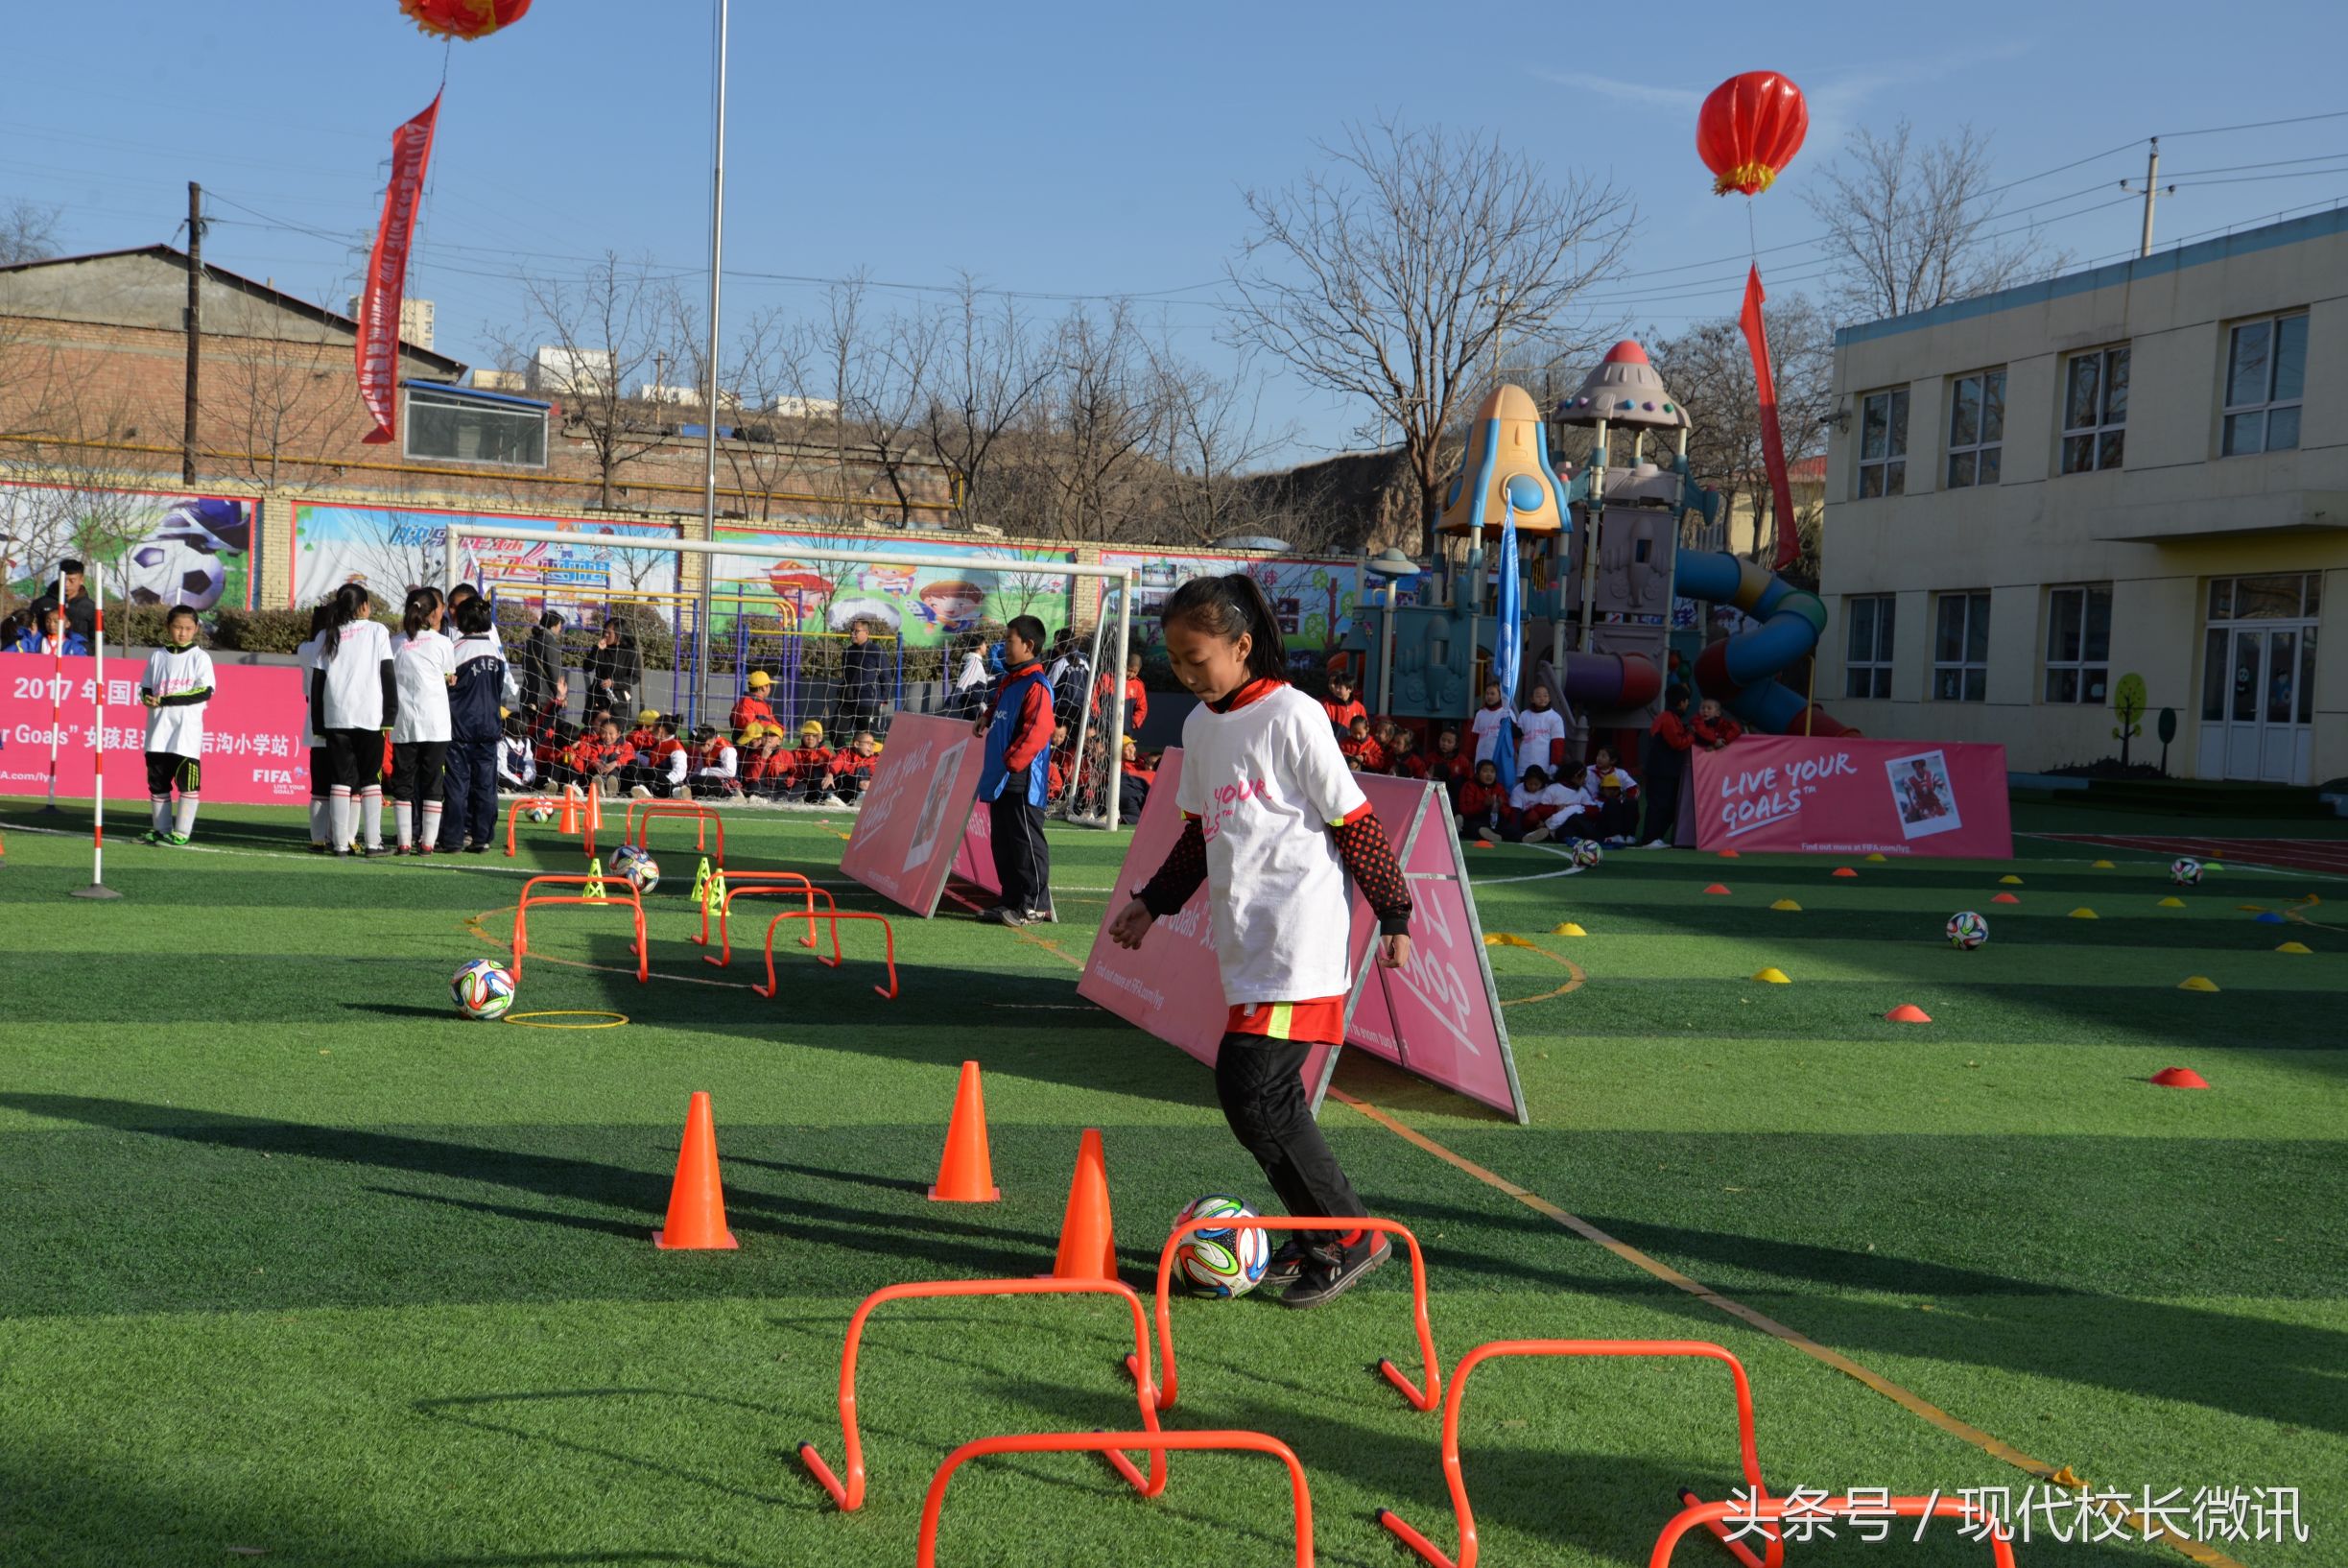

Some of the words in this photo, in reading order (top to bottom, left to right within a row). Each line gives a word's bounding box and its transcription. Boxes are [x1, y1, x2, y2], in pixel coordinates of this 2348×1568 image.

[13, 677, 73, 701] 2017
[252, 769, 292, 783] FIFA
[1721, 768, 1777, 798] LIVE
[1786, 752, 1857, 787] YOUR
[1214, 777, 1272, 811] YOUR
[1802, 843, 1818, 852] Find
[1833, 843, 1852, 852] more
